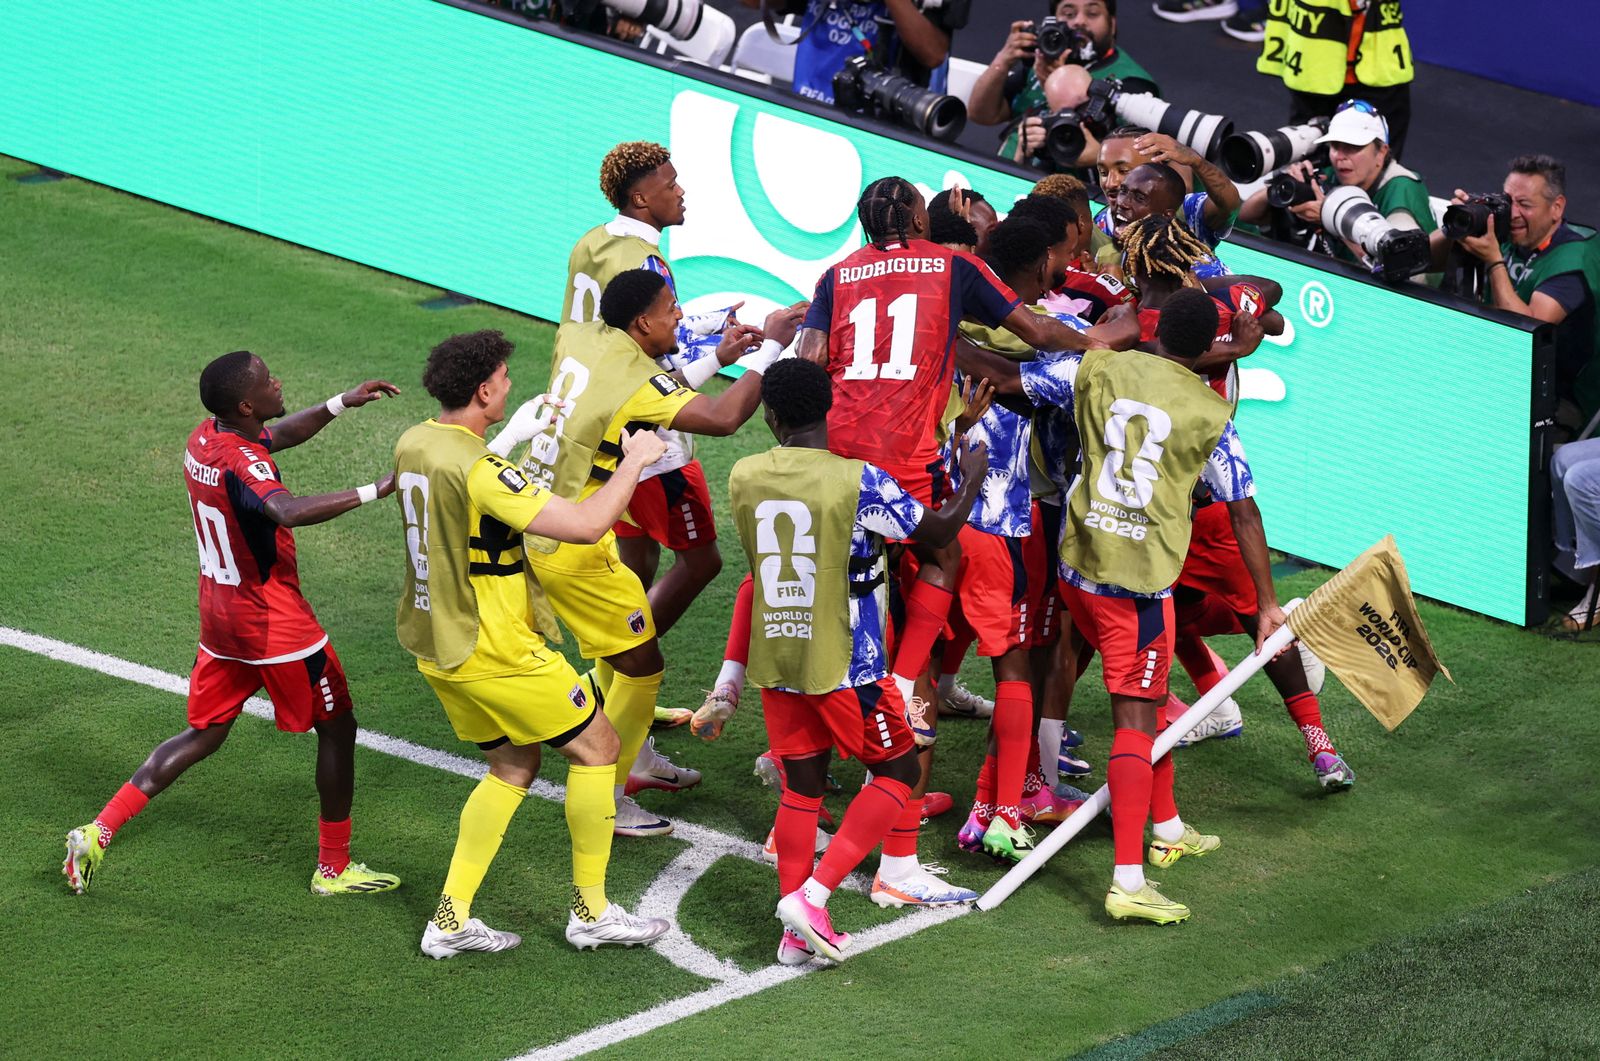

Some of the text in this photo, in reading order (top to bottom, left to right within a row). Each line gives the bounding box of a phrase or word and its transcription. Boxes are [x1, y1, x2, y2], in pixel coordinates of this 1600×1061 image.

[839, 257, 945, 284] RODRIGUES
[842, 293, 918, 381] 11
[1084, 511, 1148, 542] 2026
[1090, 499, 1150, 525] WORLD CUP
[777, 586, 806, 598] FIFA
[763, 610, 802, 622] WORLD
[1389, 609, 1410, 641] FIFA
[1356, 624, 1398, 672] 2026
[1358, 602, 1418, 669] WORLD CUP
